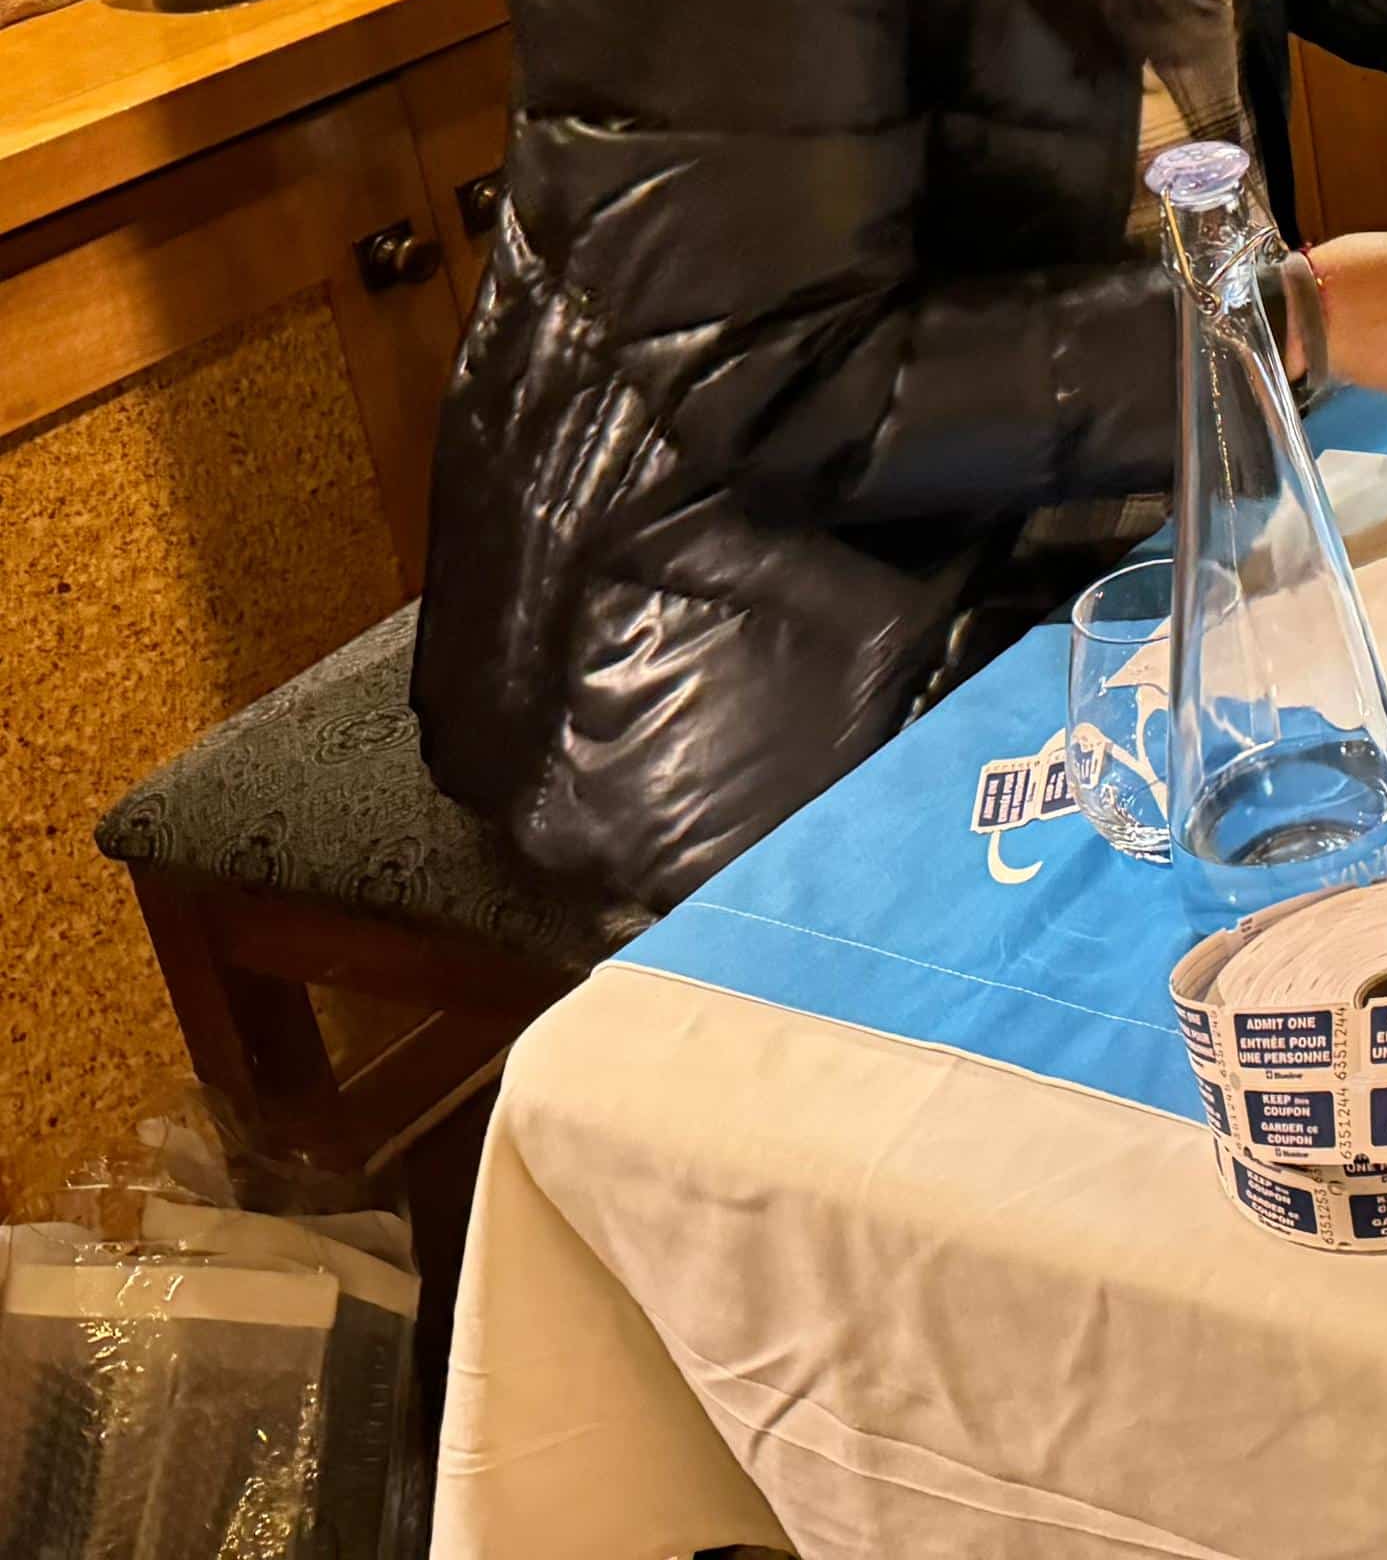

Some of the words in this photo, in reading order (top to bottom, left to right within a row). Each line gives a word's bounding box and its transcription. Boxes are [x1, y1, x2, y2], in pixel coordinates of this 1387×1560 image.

[1246, 1018, 1283, 1030] ADMIT
[1288, 1017, 1316, 1029] ONE
[1240, 1034, 1285, 1049] ENTRÉE
[1289, 1036, 1326, 1048] POUR
[1333, 1007, 1348, 1080] 6351244
[1239, 1052, 1261, 1064] UNE
[1263, 1051, 1330, 1064] PERSONNE
[1263, 1094, 1291, 1105] KEEP
[1264, 1106, 1311, 1117] COUPON
[1261, 1122, 1303, 1134] GARDER
[1336, 1088, 1352, 1160] 6351244
[1267, 1134, 1313, 1145] COUPON
[1247, 1171, 1272, 1187] KEEP
[1248, 1180, 1291, 1205] COUPON
[1245, 1190, 1285, 1214] GARDER
[1251, 1202, 1295, 1227] COUPON
[1315, 1188, 1335, 1245] 6351253
